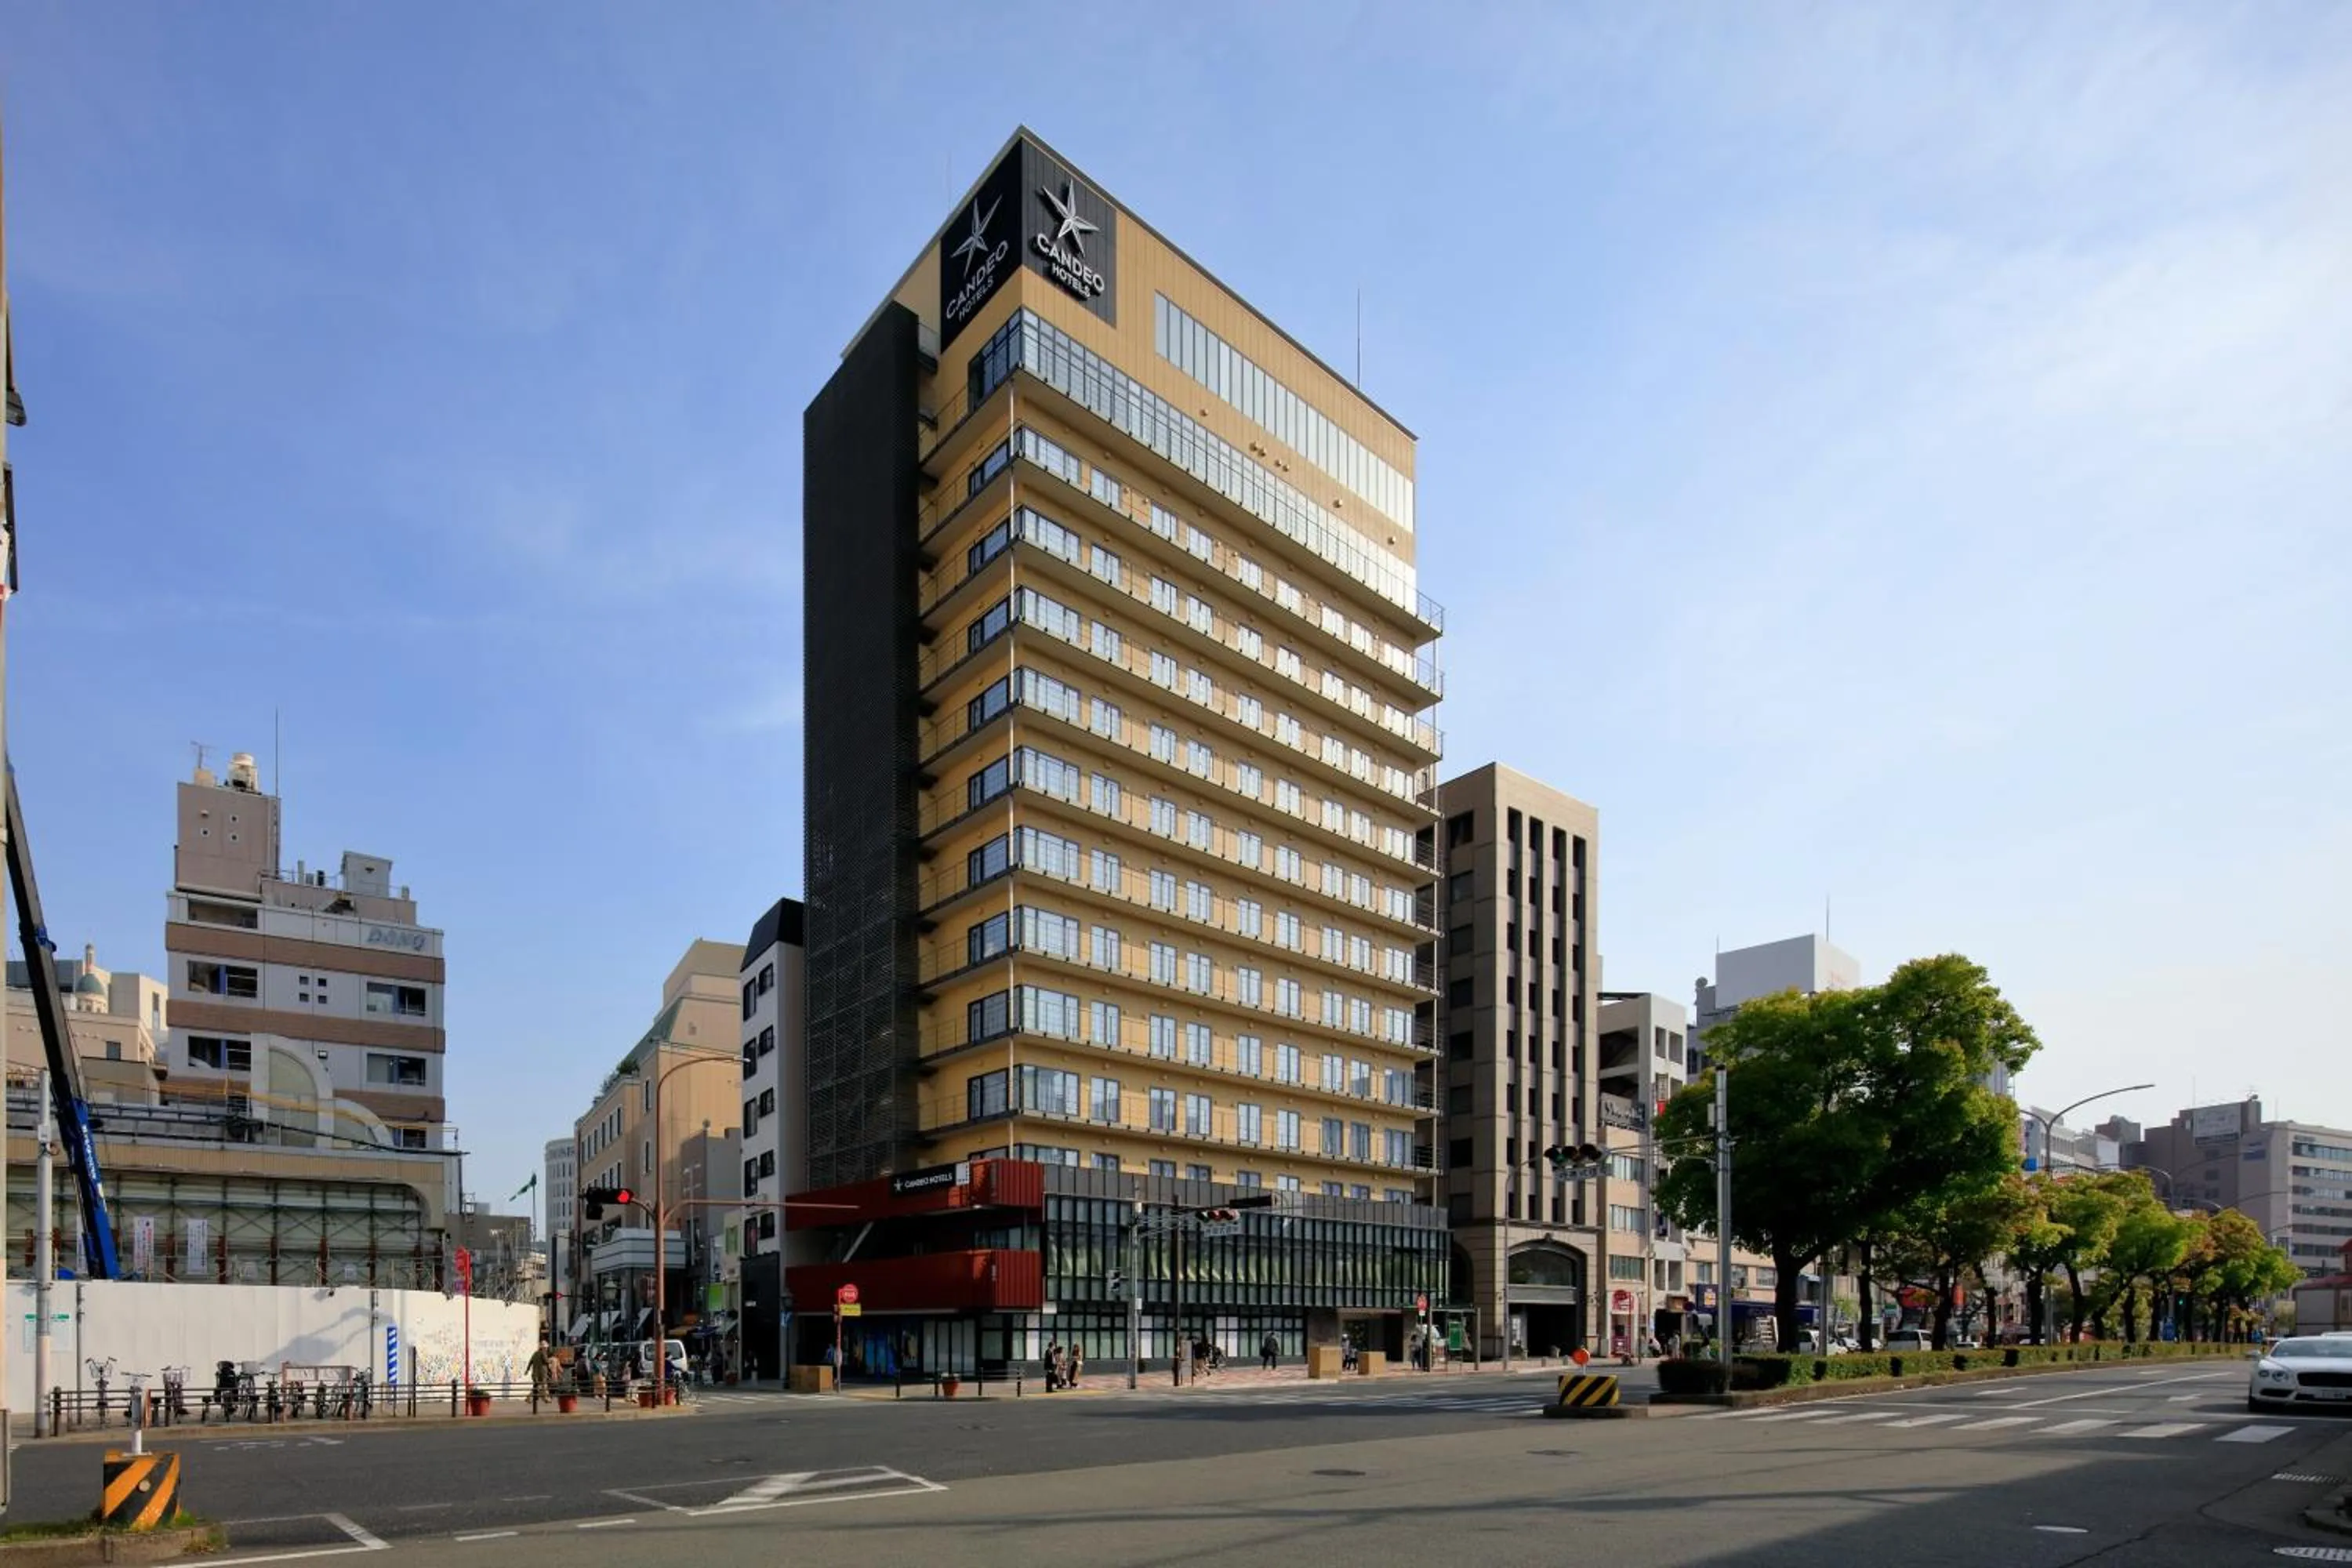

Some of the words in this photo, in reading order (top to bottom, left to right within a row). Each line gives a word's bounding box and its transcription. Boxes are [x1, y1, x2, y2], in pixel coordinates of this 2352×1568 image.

[946, 240, 1009, 319] CANDEO
[1036, 233, 1105, 292] CANDEO
[1052, 263, 1091, 298] HOTELS
[959, 275, 994, 322] HOTELS
[905, 1177, 928, 1189] CANDEO
[930, 1172, 953, 1184] HOTELS
